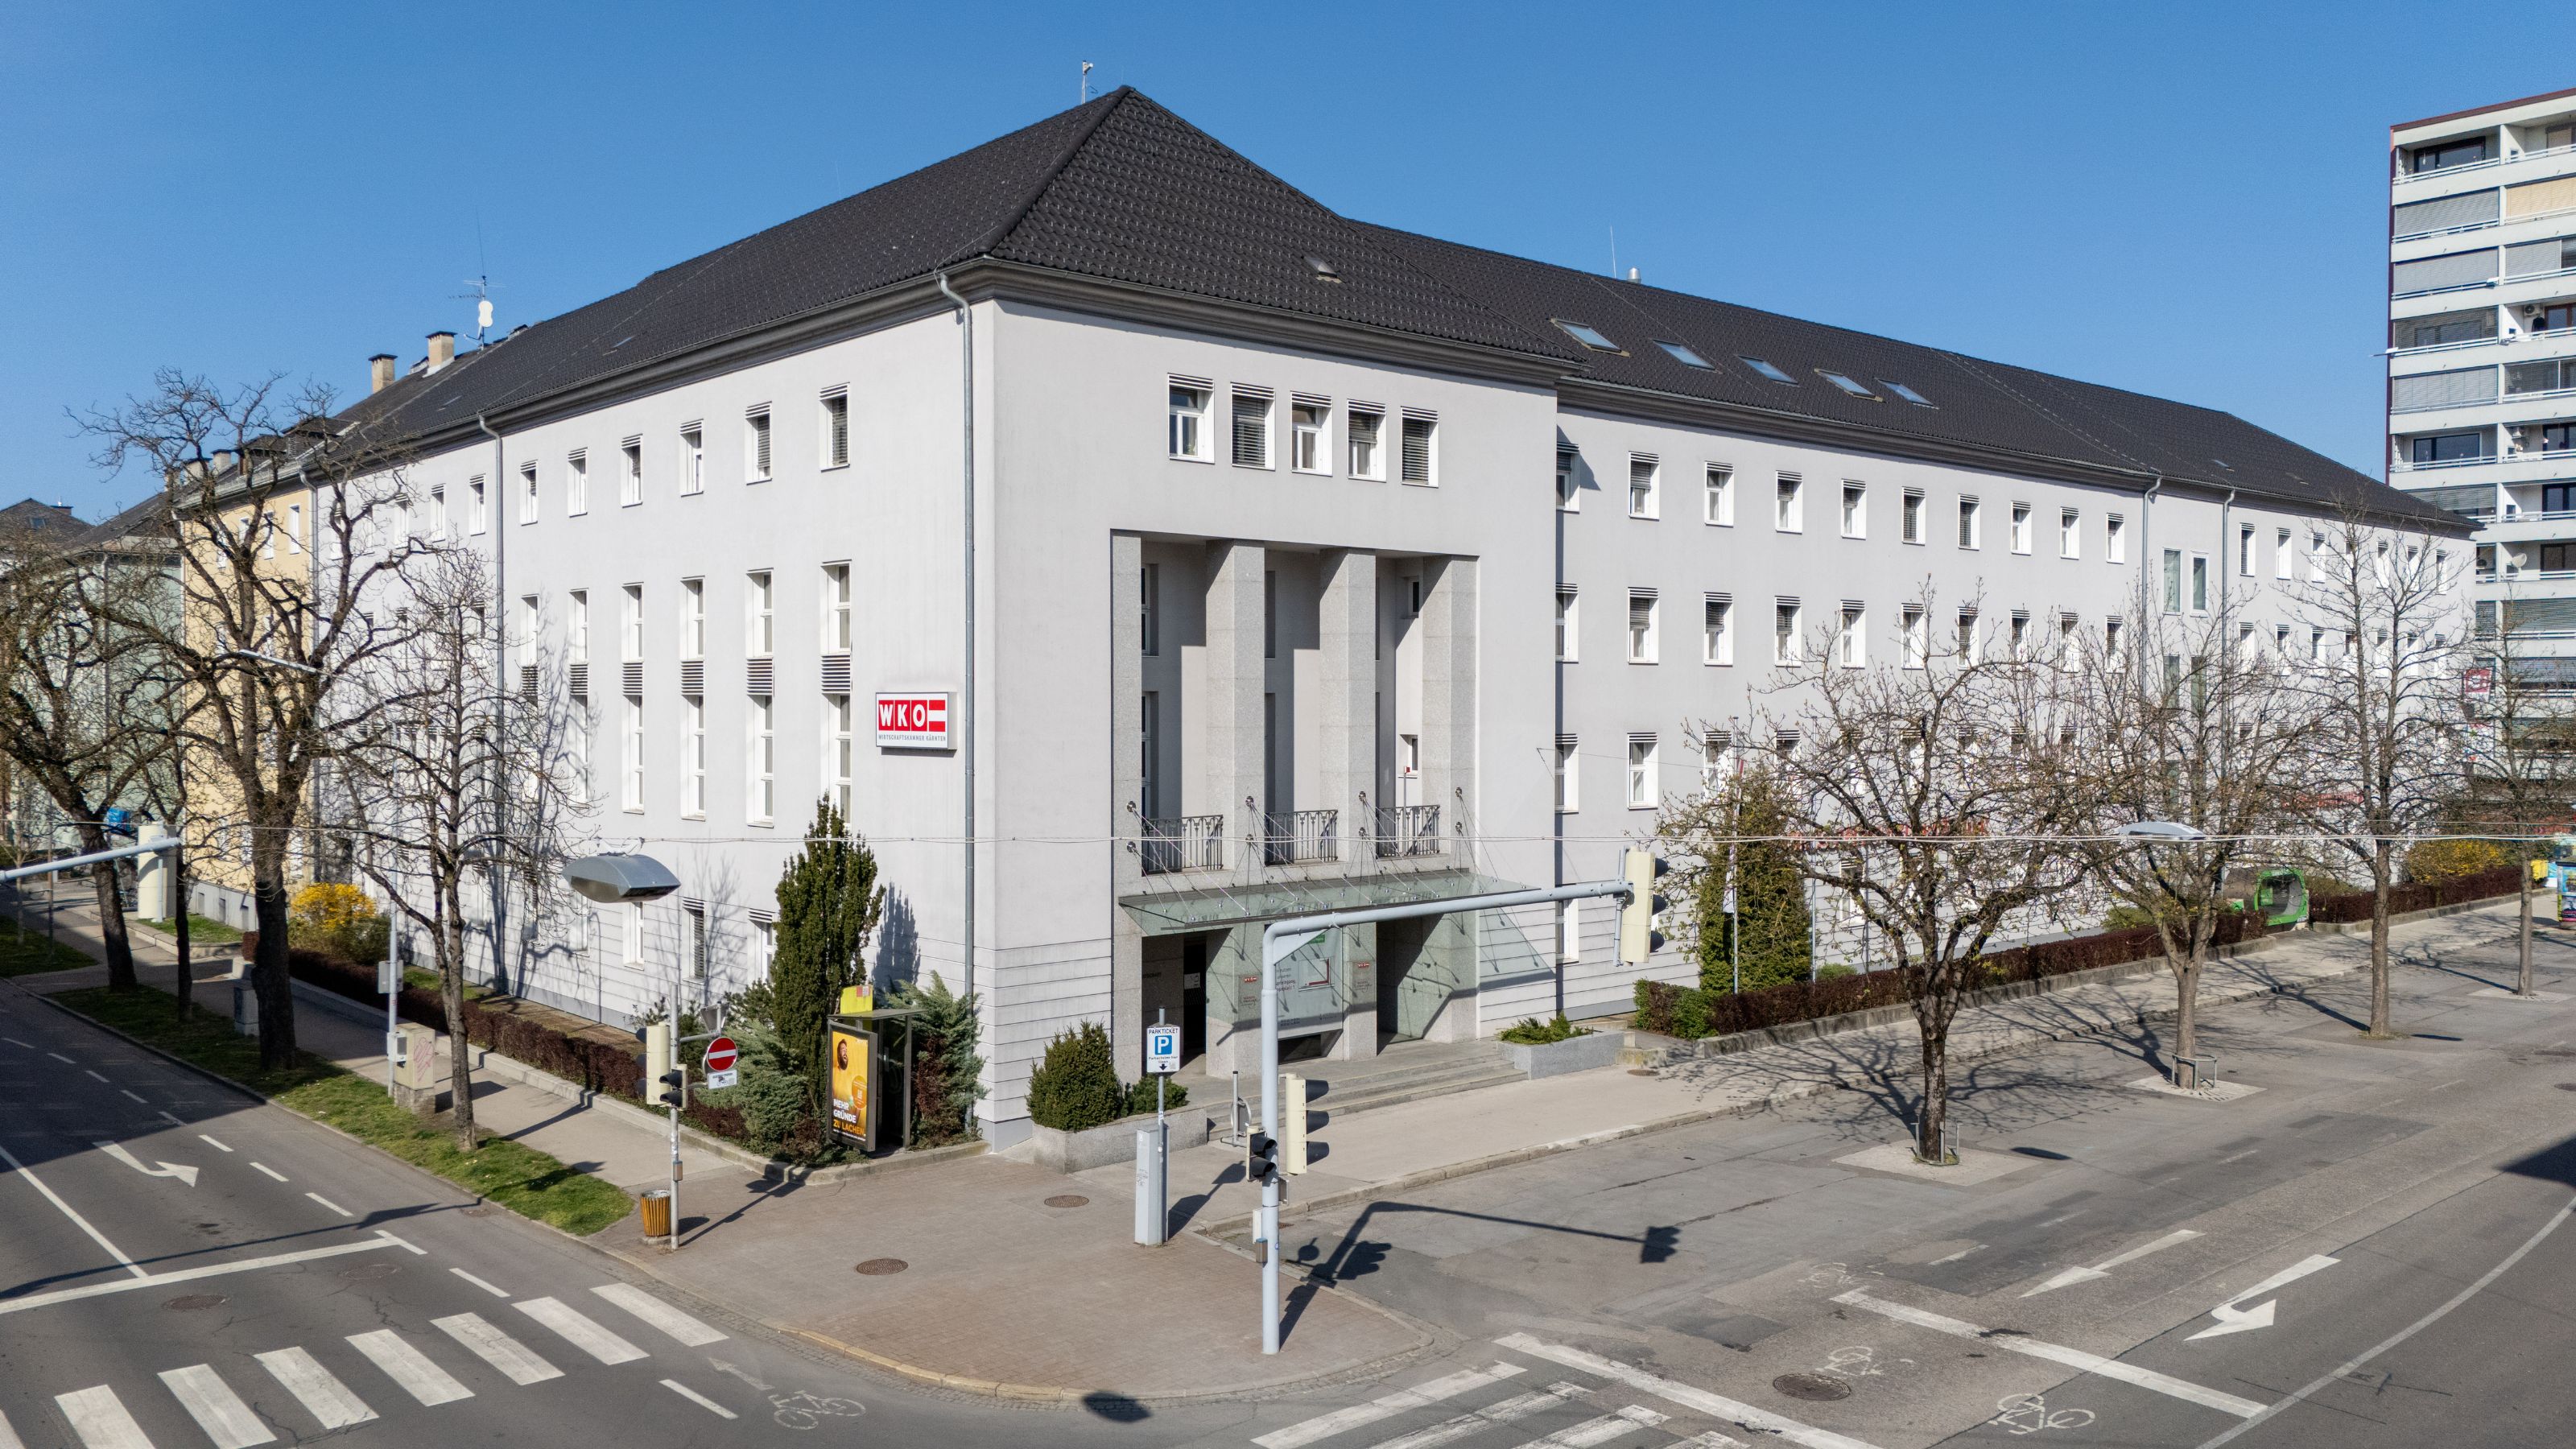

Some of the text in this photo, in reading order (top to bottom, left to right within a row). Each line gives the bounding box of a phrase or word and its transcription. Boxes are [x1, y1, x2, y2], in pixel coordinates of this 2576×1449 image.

[879, 704, 926, 727] WKO
[926, 733, 946, 741] KÄRNTEN
[1158, 1036, 1170, 1054] P
[833, 1098, 849, 1111] MEHR
[833, 1108, 857, 1123] GRÜNDE
[833, 1119, 841, 1129] ZU
